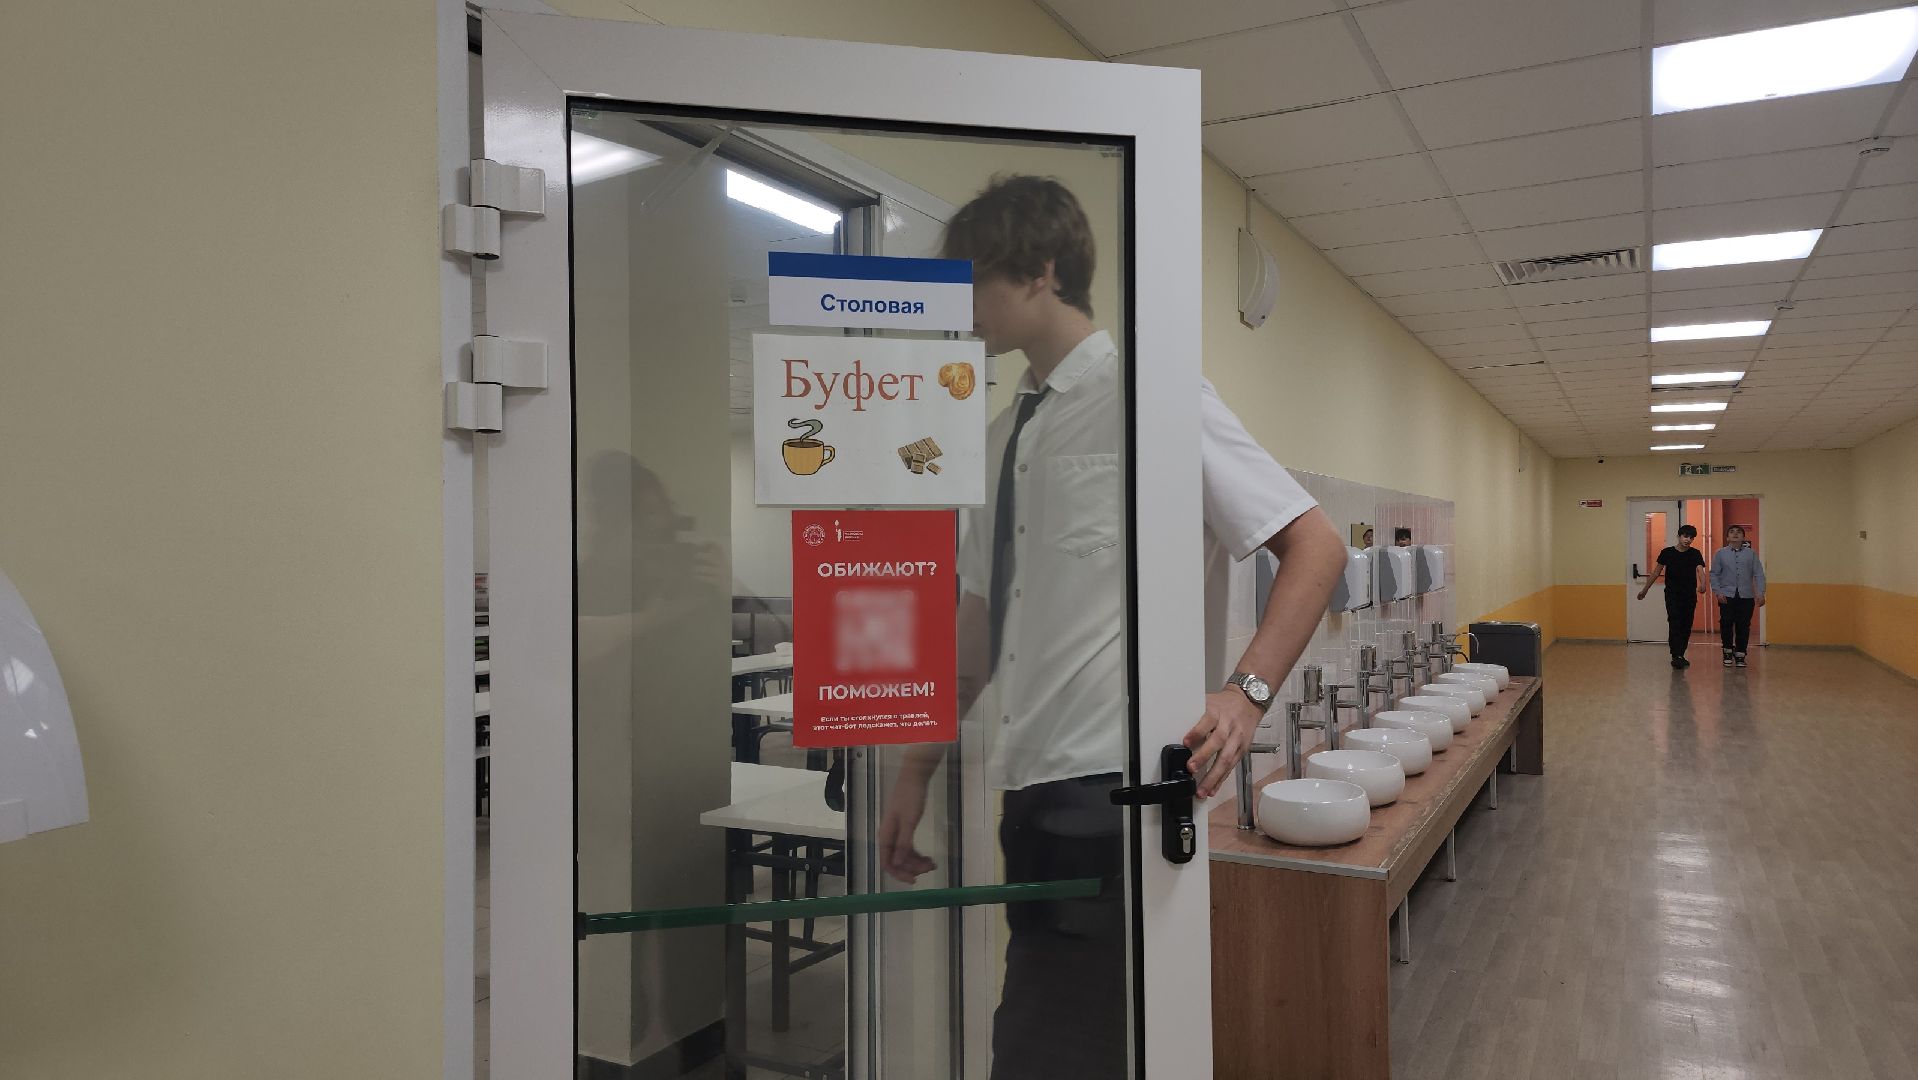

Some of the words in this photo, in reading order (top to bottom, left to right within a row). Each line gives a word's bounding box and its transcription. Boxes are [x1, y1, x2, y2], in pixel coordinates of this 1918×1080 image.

[820, 293, 925, 315] Столовая
[781, 358, 924, 412] Буфет
[817, 561, 938, 578] ОБИЖАЮТ?
[818, 681, 936, 701] ПОМОЖЕМ!
[850, 713, 893, 721] столкнулся
[898, 711, 930, 720] травлей,
[858, 721, 899, 730] подскажет,
[912, 719, 938, 727] делать
